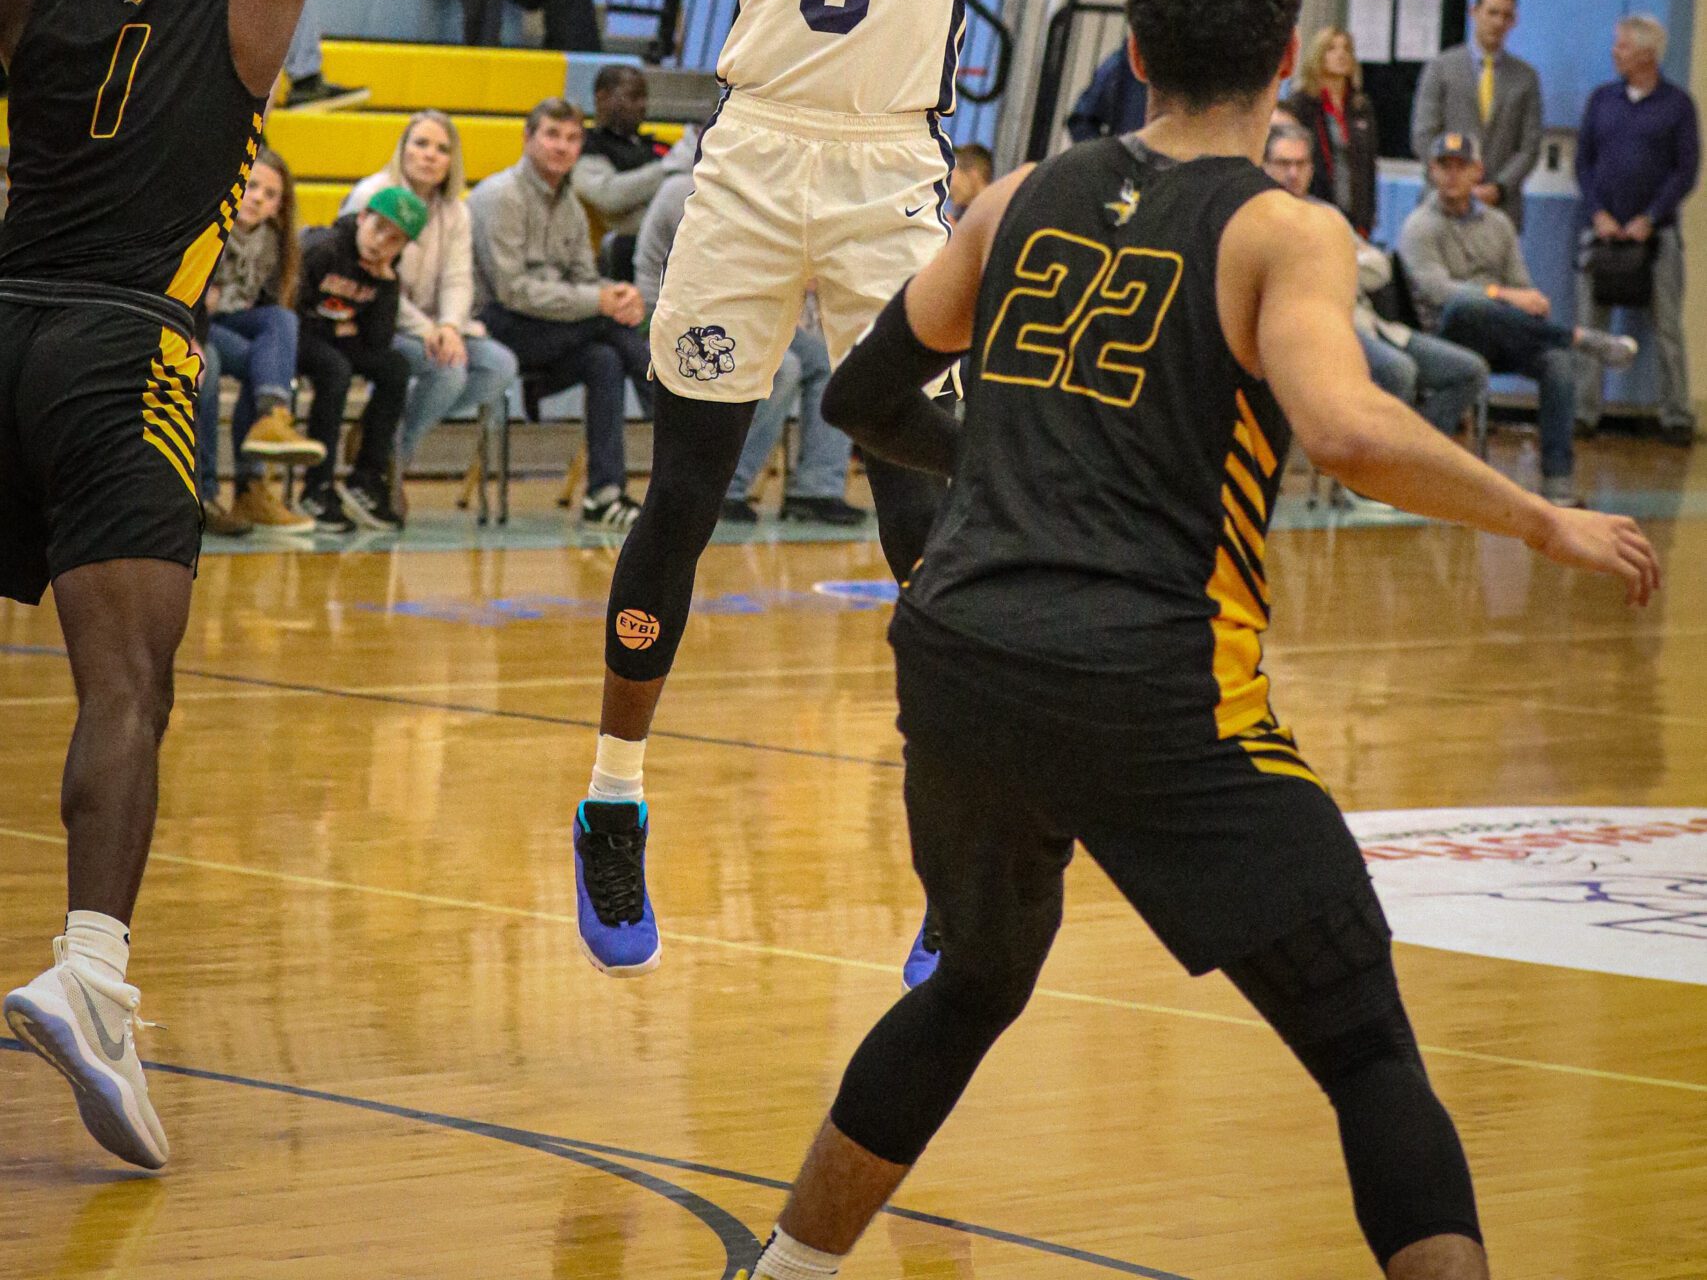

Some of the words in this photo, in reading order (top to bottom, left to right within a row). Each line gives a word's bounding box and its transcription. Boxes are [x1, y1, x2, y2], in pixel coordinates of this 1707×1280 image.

[90, 23, 151, 139] 1
[981, 228, 1184, 408] 22
[620, 617, 656, 634] EYBL
